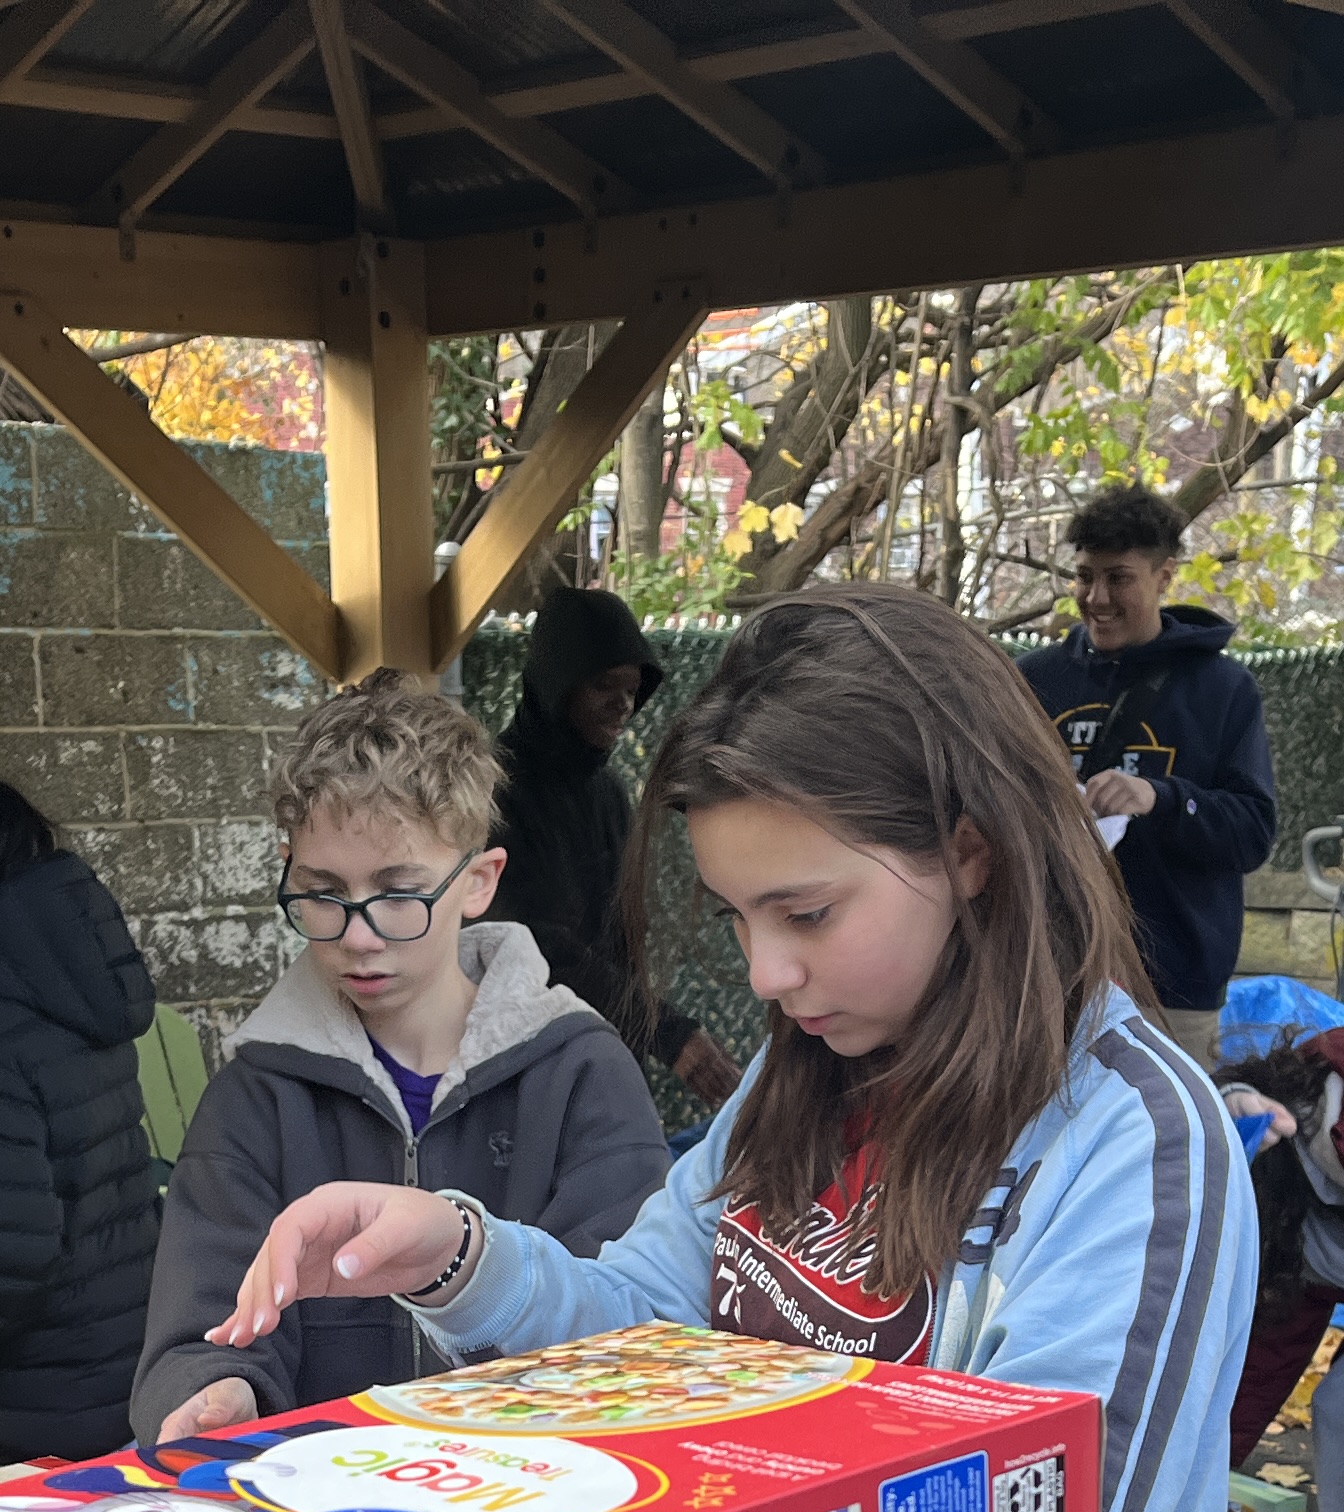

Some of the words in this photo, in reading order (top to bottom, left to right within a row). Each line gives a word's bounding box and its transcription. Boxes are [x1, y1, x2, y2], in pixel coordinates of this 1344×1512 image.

[737, 1247, 815, 1340] Intermediate
[814, 1325, 877, 1354] School
[332, 1447, 548, 1512] Magic
[429, 1438, 574, 1484] Treasures
